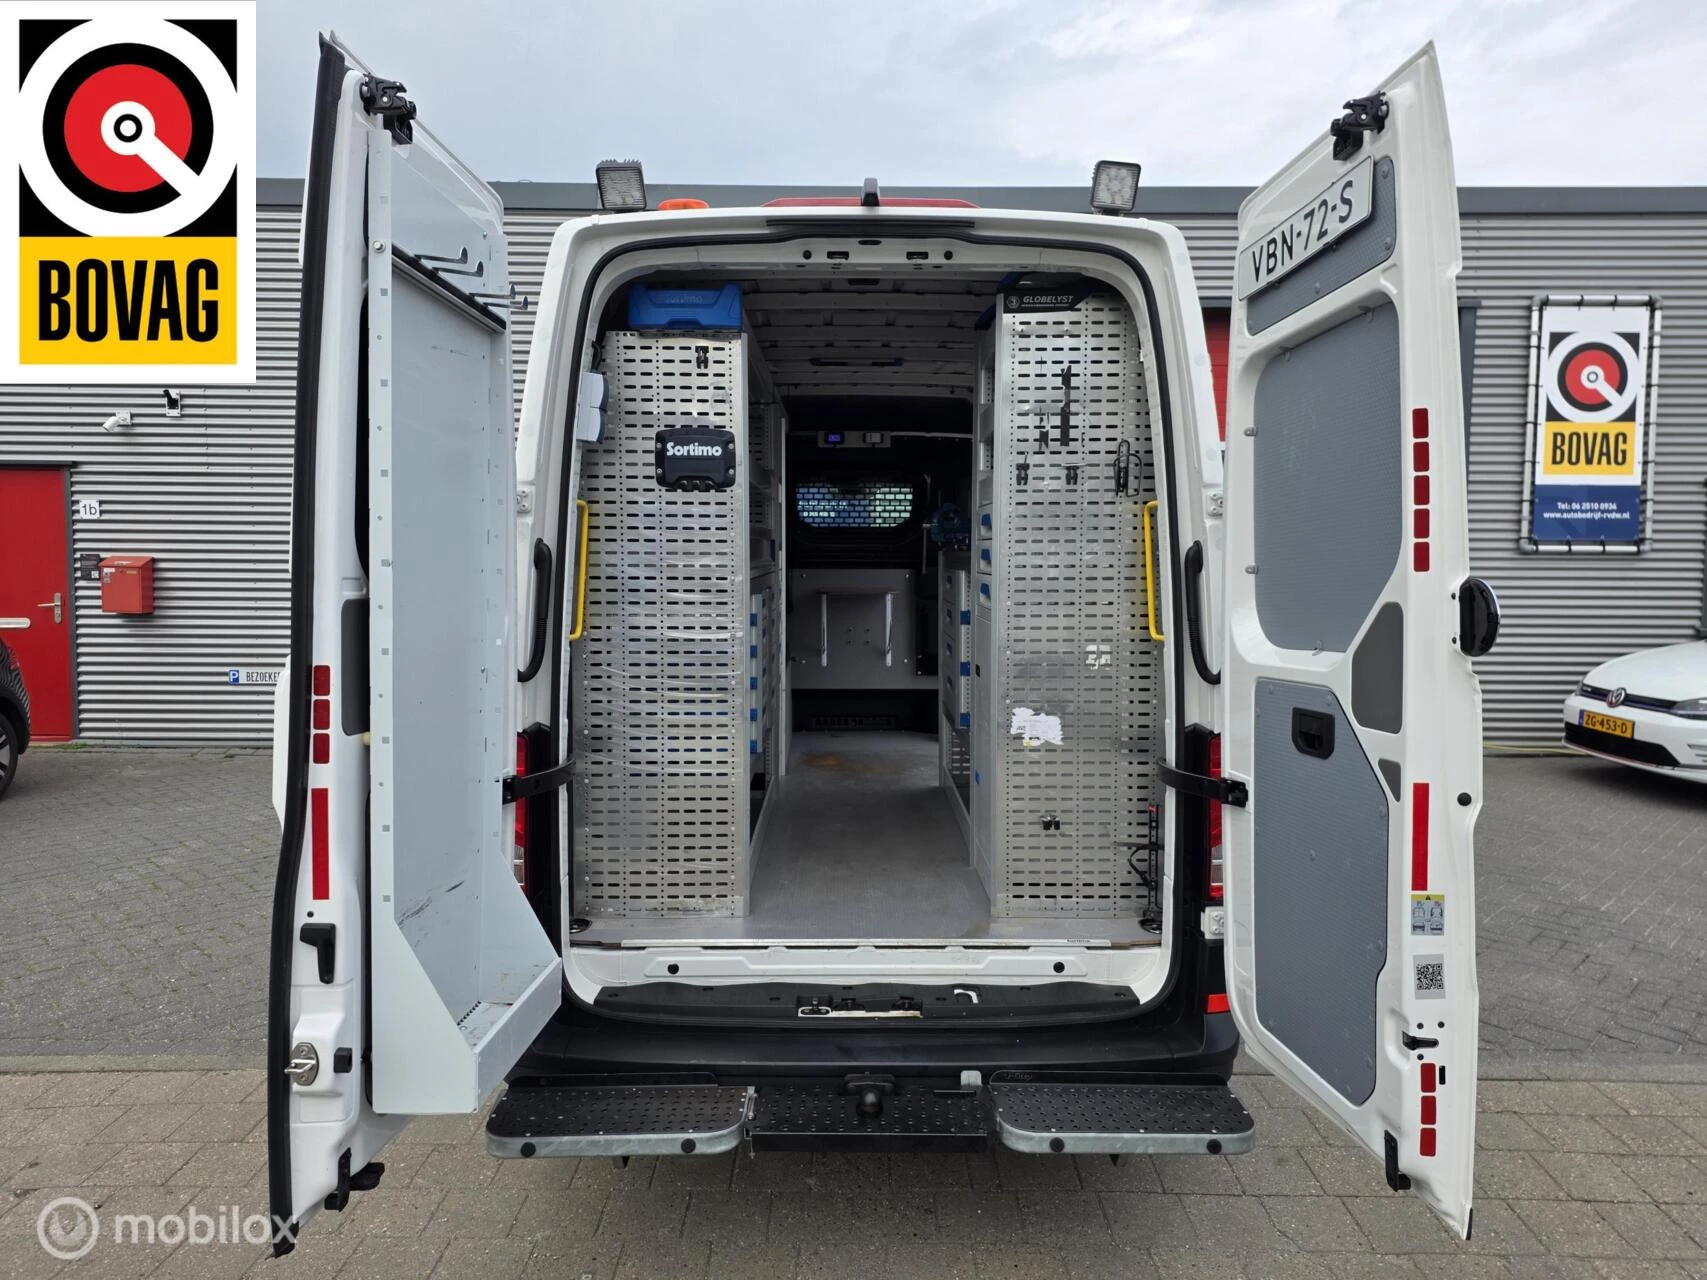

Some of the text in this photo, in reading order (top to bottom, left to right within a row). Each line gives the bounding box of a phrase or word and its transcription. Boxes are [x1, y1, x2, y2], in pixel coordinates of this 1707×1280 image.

[1252, 179, 1353, 282] VBN-72-S
[1022, 295, 1074, 303] GLOBELYST
[666, 441, 722, 456] Sortimo
[1551, 431, 1628, 466] BOVAG
[82, 503, 98, 516] 1b
[1571, 502, 1580, 510] 06
[1584, 713, 1628, 734] ZG-453-D
